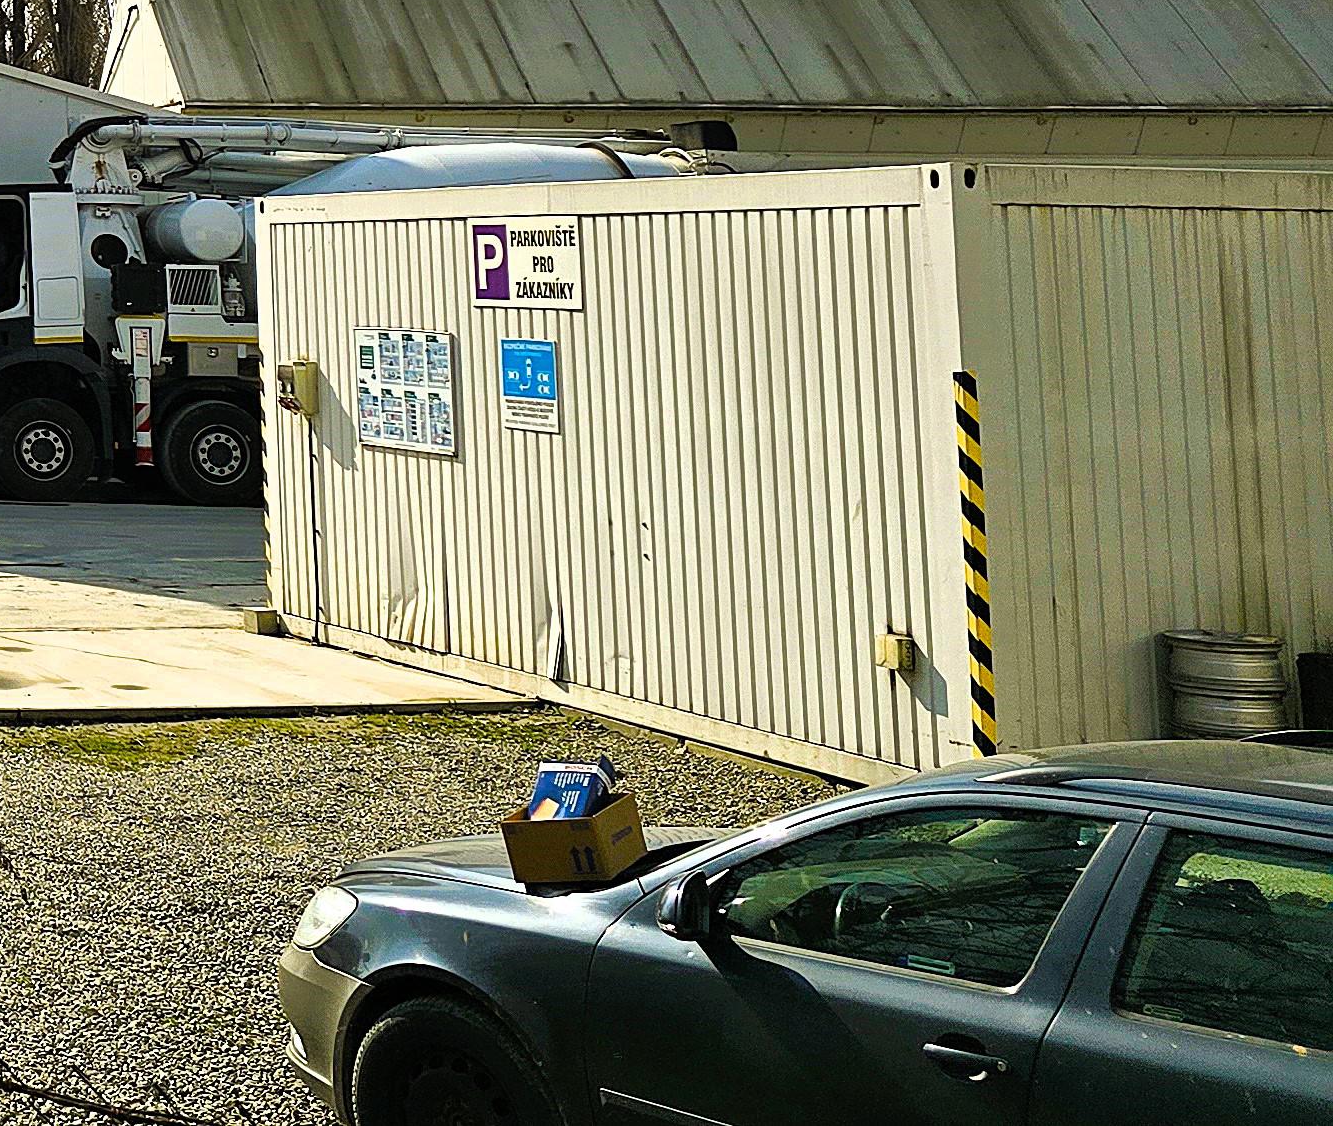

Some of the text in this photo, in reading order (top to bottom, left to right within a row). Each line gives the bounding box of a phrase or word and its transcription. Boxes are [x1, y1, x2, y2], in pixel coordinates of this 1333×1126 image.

[509, 224, 577, 247] PARKOVIŠTĚ
[476, 234, 505, 290] P
[532, 255, 554, 273] PRO
[515, 276, 575, 300] ZÁKAZNÍKY
